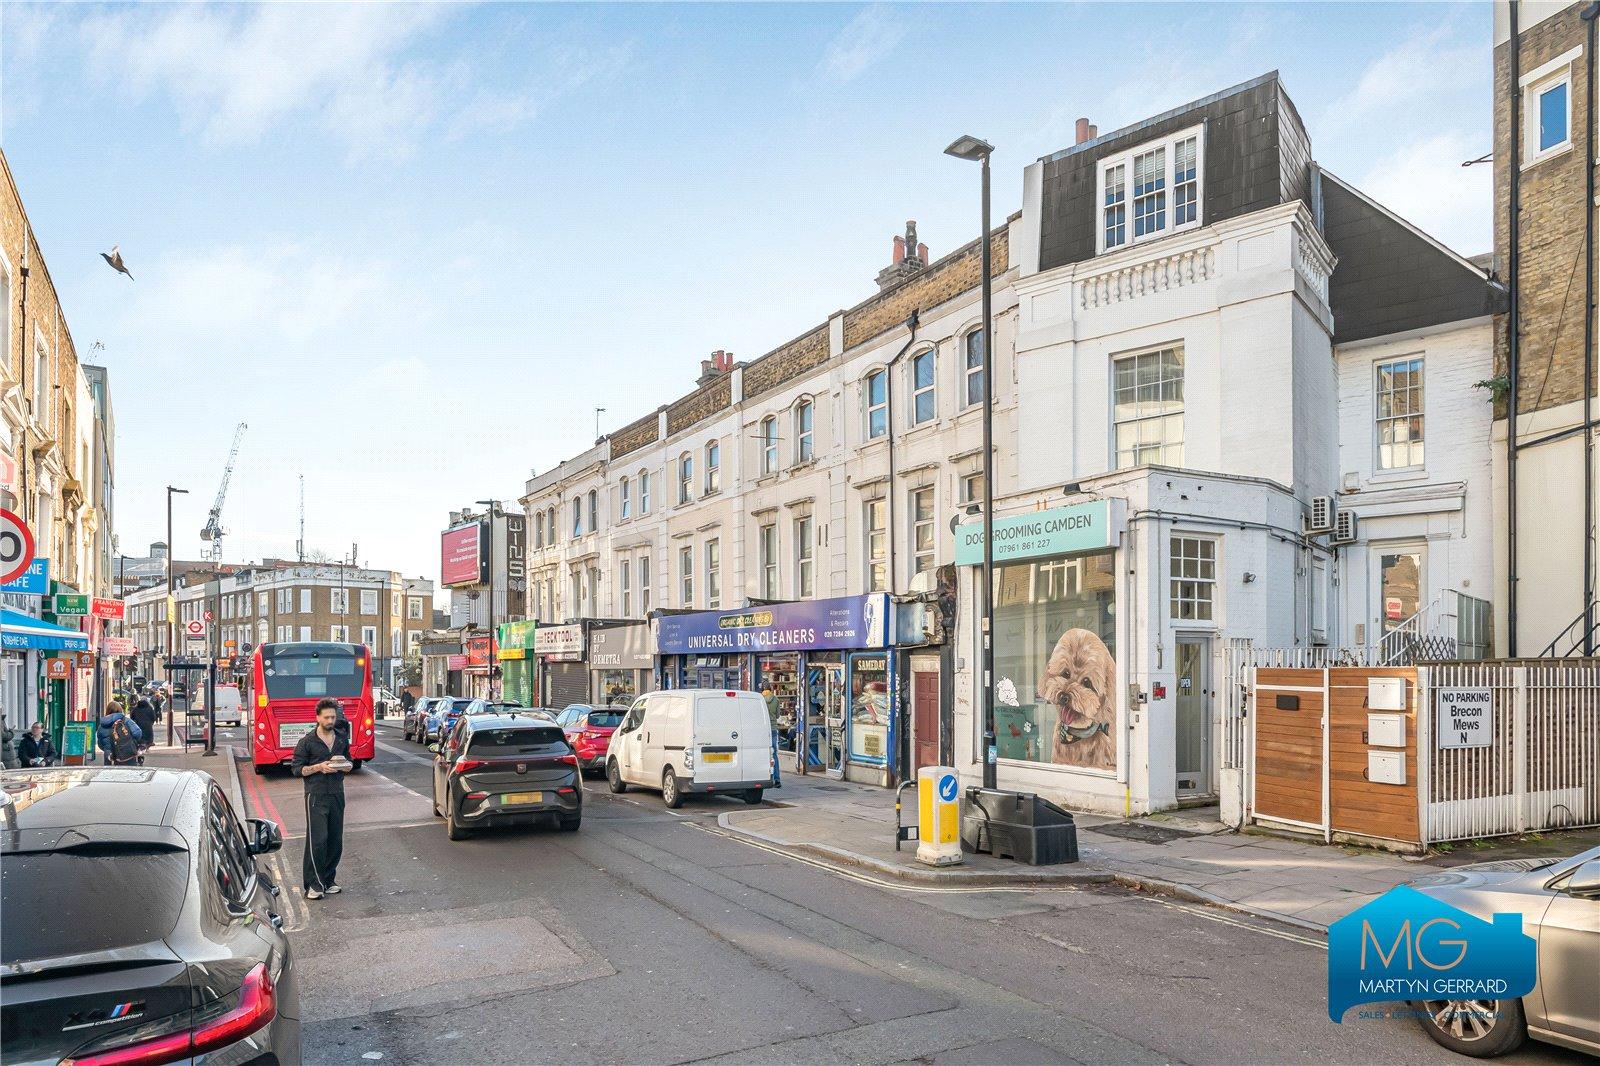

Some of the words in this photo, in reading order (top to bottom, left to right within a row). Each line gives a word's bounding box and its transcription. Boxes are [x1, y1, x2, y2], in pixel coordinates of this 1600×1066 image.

[992, 522, 1042, 541] ROOMING
[1044, 513, 1092, 535] CAMDEN
[999, 543, 1019, 554] 07961
[1022, 541, 1034, 551] 861
[1037, 539, 1051, 549] 227
[60, 606, 85, 614] Vegan
[204, 611, 211, 620] K
[688, 634, 733, 649] UNIVERSAL
[737, 632, 756, 647] DRY
[759, 628, 815, 646] CLEANERS
[593, 653, 621, 665] DEMETRA
[857, 659, 885, 671] SAMEDAY
[1443, 693, 1454, 703] NO
[1456, 692, 1490, 703] PARKING
[1451, 705, 1482, 717] Brecon
[1454, 719, 1479, 730] Mews
[1461, 732, 1468, 744] N
[94, 1013, 144, 1025] competition
